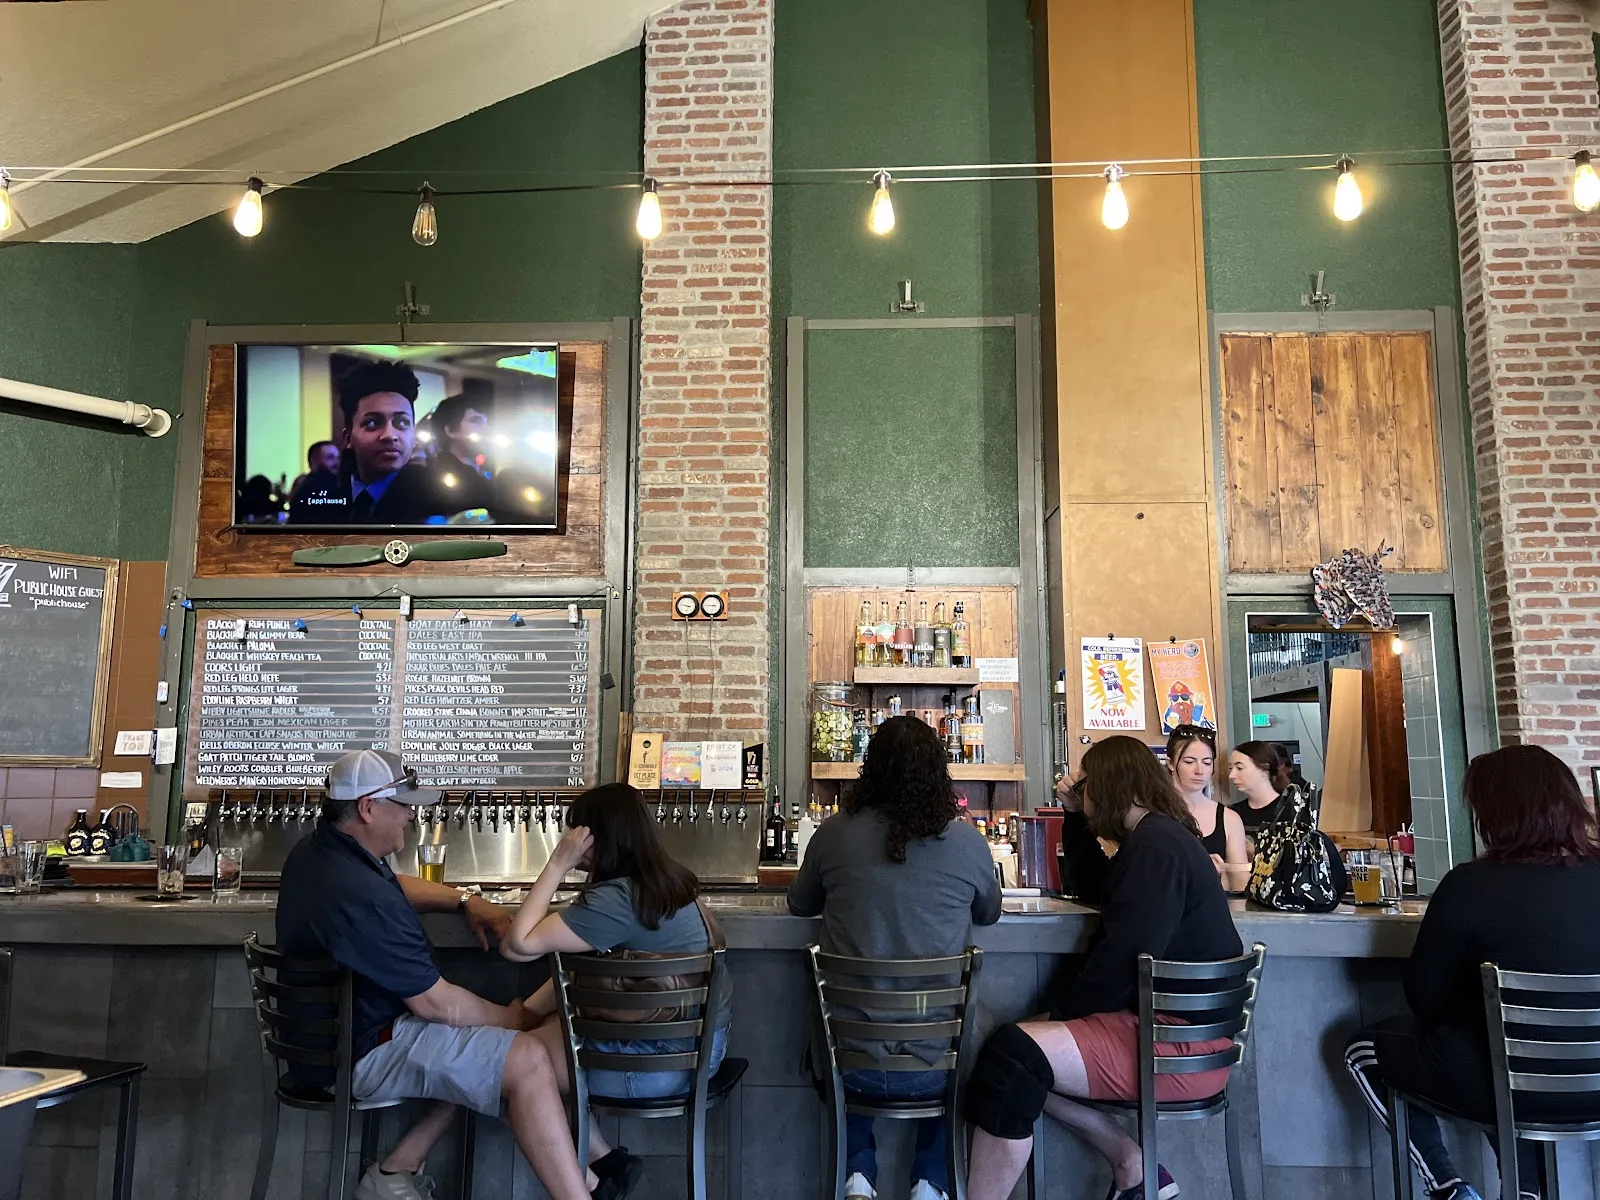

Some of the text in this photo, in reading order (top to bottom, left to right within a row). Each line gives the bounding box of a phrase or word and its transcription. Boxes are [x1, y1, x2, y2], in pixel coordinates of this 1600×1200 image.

[49, 566, 77, 579] WIFI
[79, 587, 104, 598] GUEST
[208, 620, 392, 629] BLACKH RUM PUNCH COCKTAIL
[409, 620, 492, 629] GOAT PATCH HAZY
[207, 631, 237, 639] BLACKH
[245, 631, 258, 639] GIN
[259, 631, 286, 639] GUMMY
[359, 631, 391, 639] COCKTAIL
[442, 631, 465, 640] EASY
[469, 632, 483, 640] IPA
[207, 642, 391, 650] BLACKHAT PALOMA COCKTAIL
[407, 642, 422, 650] RED
[206, 652, 245, 660] BLACKHAT
[246, 652, 280, 660] WHISKEY
[281, 653, 304, 661] PEACH
[359, 652, 391, 660] COCKTAIL
[407, 652, 447, 660] INDUSTRIAL
[491, 653, 519, 661] WRENCH
[535, 653, 547, 661] IPA
[205, 663, 263, 672] COORS LIGHT
[406, 663, 507, 672] OSKAR BLUES DALES PALE ALE
[205, 674, 279, 682] RED LEG HELO HEFE
[405, 674, 491, 683] ROGUE HAZELNUT BROWN
[231, 685, 260, 693] SPRINGS
[405, 685, 426, 693] PIKES
[428, 685, 446, 693] PEAK
[236, 696, 273, 705] RASPBERRY
[274, 696, 299, 704] WHEAT
[404, 696, 419, 704] RED
[420, 696, 435, 704] LEG
[437, 696, 472, 704] HOWITZER
[403, 708, 433, 716] CROOKED
[434, 708, 454, 716] STAVE
[456, 708, 478, 716] CINNA
[527, 708, 547, 716] STOUT
[1101, 707, 1126, 716] NOW
[203, 718, 224, 726] PIKES
[226, 718, 249, 726] PEAK
[277, 718, 317, 726] MEXICAN
[403, 719, 435, 727] MOTHER
[436, 719, 460, 728] EARTH
[490, 719, 513, 728] PEANUT
[553, 720, 574, 728] STOUT
[1089, 719, 1140, 727] AVAILABLE
[200, 730, 224, 739] URBAN
[323, 730, 345, 738] PUNCH
[402, 730, 426, 738] URBAN
[427, 731, 455, 739] ANIMAL
[457, 731, 493, 739] SOMETHING
[515, 731, 537, 739] WATER
[317, 742, 345, 750] WHEAT
[401, 742, 437, 750] EDDYLINE
[439, 742, 460, 750] JOLLY
[462, 743, 486, 751] ROGER
[512, 742, 533, 750] LAGER
[198, 753, 220, 762] GOAT
[220, 753, 242, 762] PATCH
[244, 754, 268, 762] TIGER
[288, 754, 315, 762] BLONDE
[402, 754, 420, 762] STEM
[421, 754, 458, 762] BLUEBERRY
[460, 754, 477, 762] LIME
[478, 754, 499, 762] CIDER
[199, 765, 221, 773] WILEY
[223, 765, 249, 773] ROOTS
[251, 765, 283, 773] COBBLER
[286, 765, 327, 773] BLUEBERRY
[436, 765, 523, 775] EXCELSIOR IMPERIAL APPLE
[196, 776, 306, 785] WELDWERKS MANGO HONEYDEW
[568, 777, 585, 786] N/A
